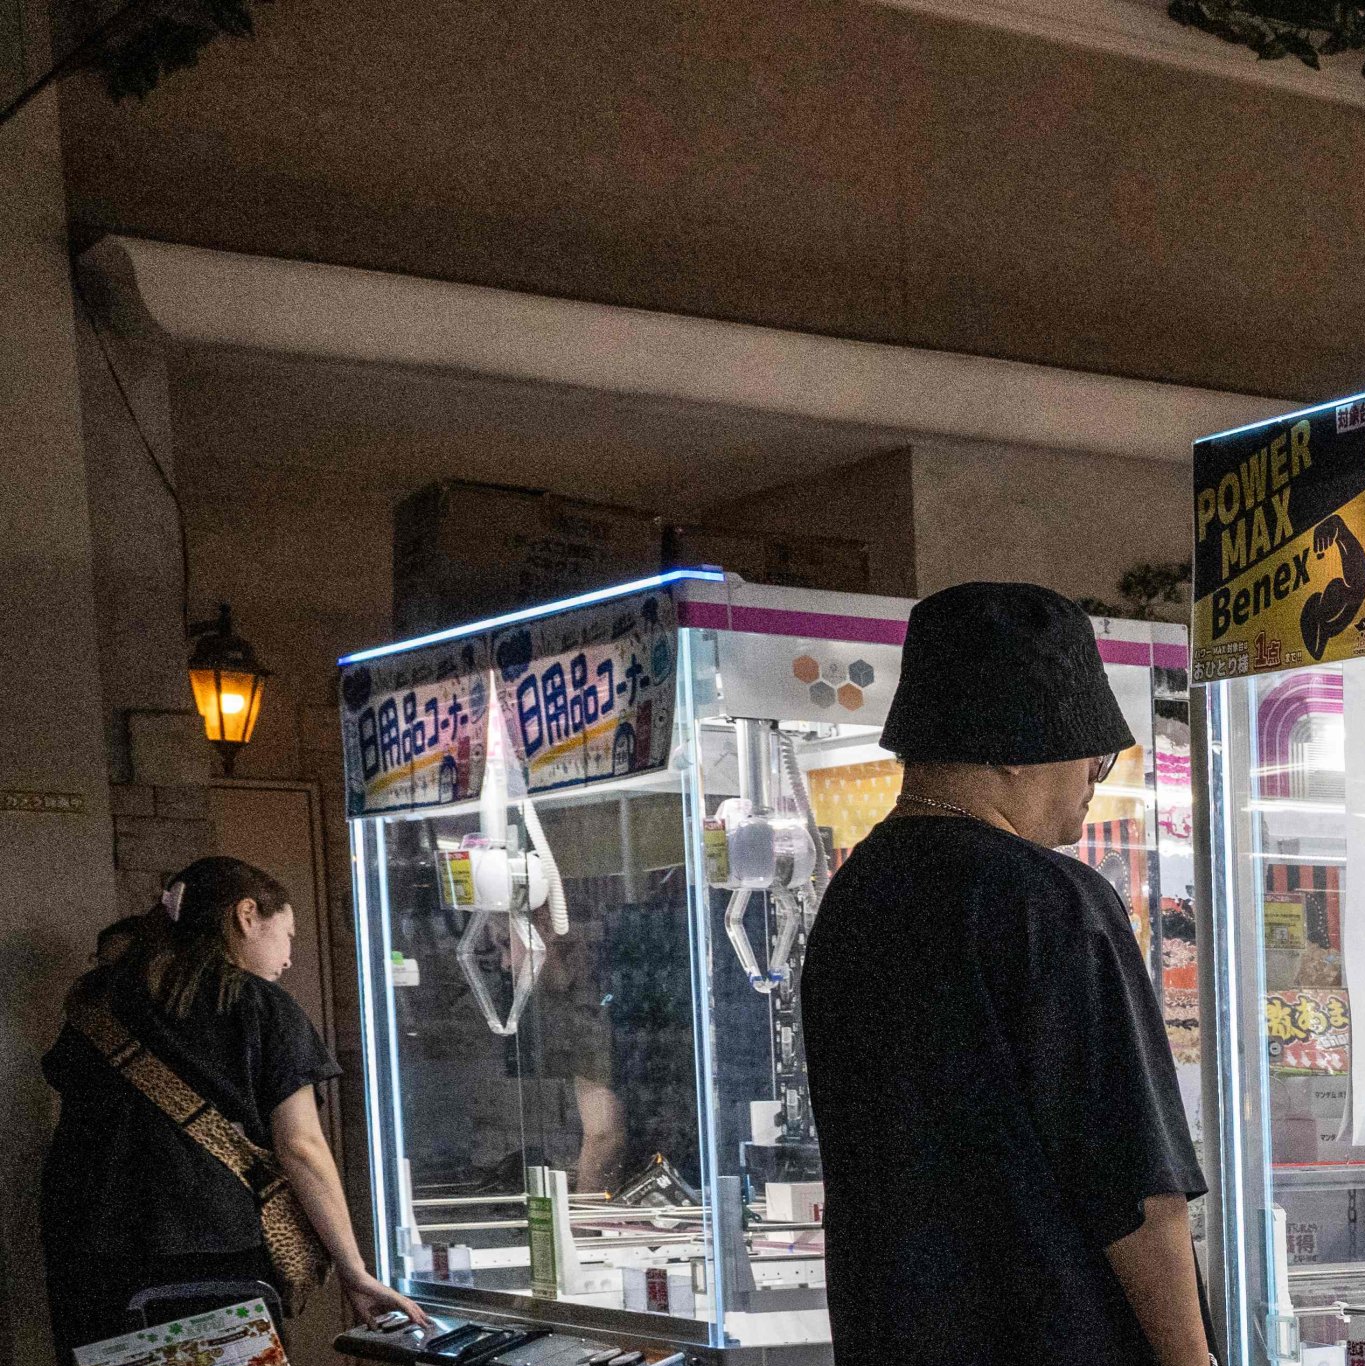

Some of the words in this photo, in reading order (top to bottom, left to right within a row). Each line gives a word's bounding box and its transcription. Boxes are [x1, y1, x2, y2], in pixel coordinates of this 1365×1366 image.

[1198, 419, 1313, 543] POWER
[1221, 487, 1295, 580] MAX
[1212, 546, 1312, 641] Benex
[515, 651, 651, 757] 日用品コーナー
[1193, 654, 1250, 680] おひとり様
[357, 690, 470, 783] 日用品コーナー
